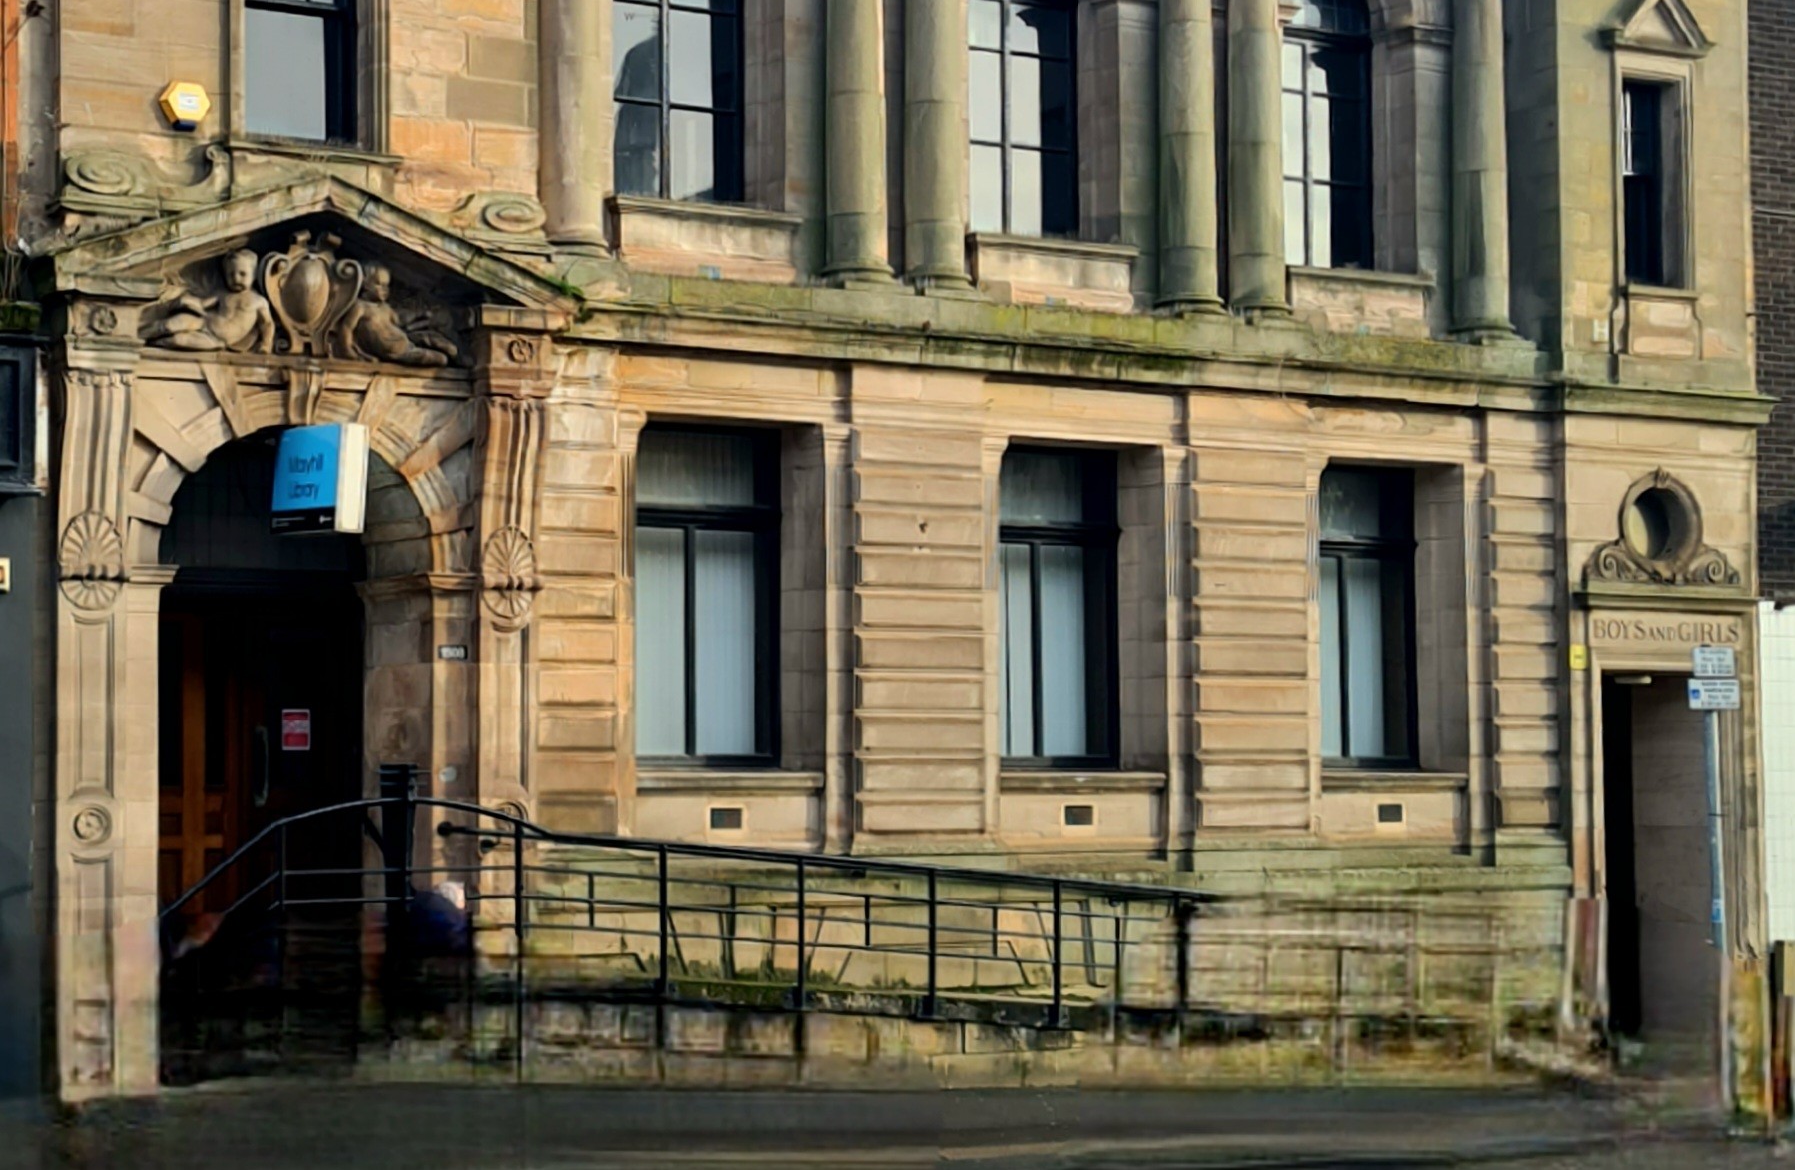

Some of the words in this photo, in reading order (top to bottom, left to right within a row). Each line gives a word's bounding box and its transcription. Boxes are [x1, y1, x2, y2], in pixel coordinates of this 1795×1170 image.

[1593, 619, 1646, 640] BOYS
[1649, 626, 1675, 641] AND
[1677, 621, 1739, 643] GIRLS
